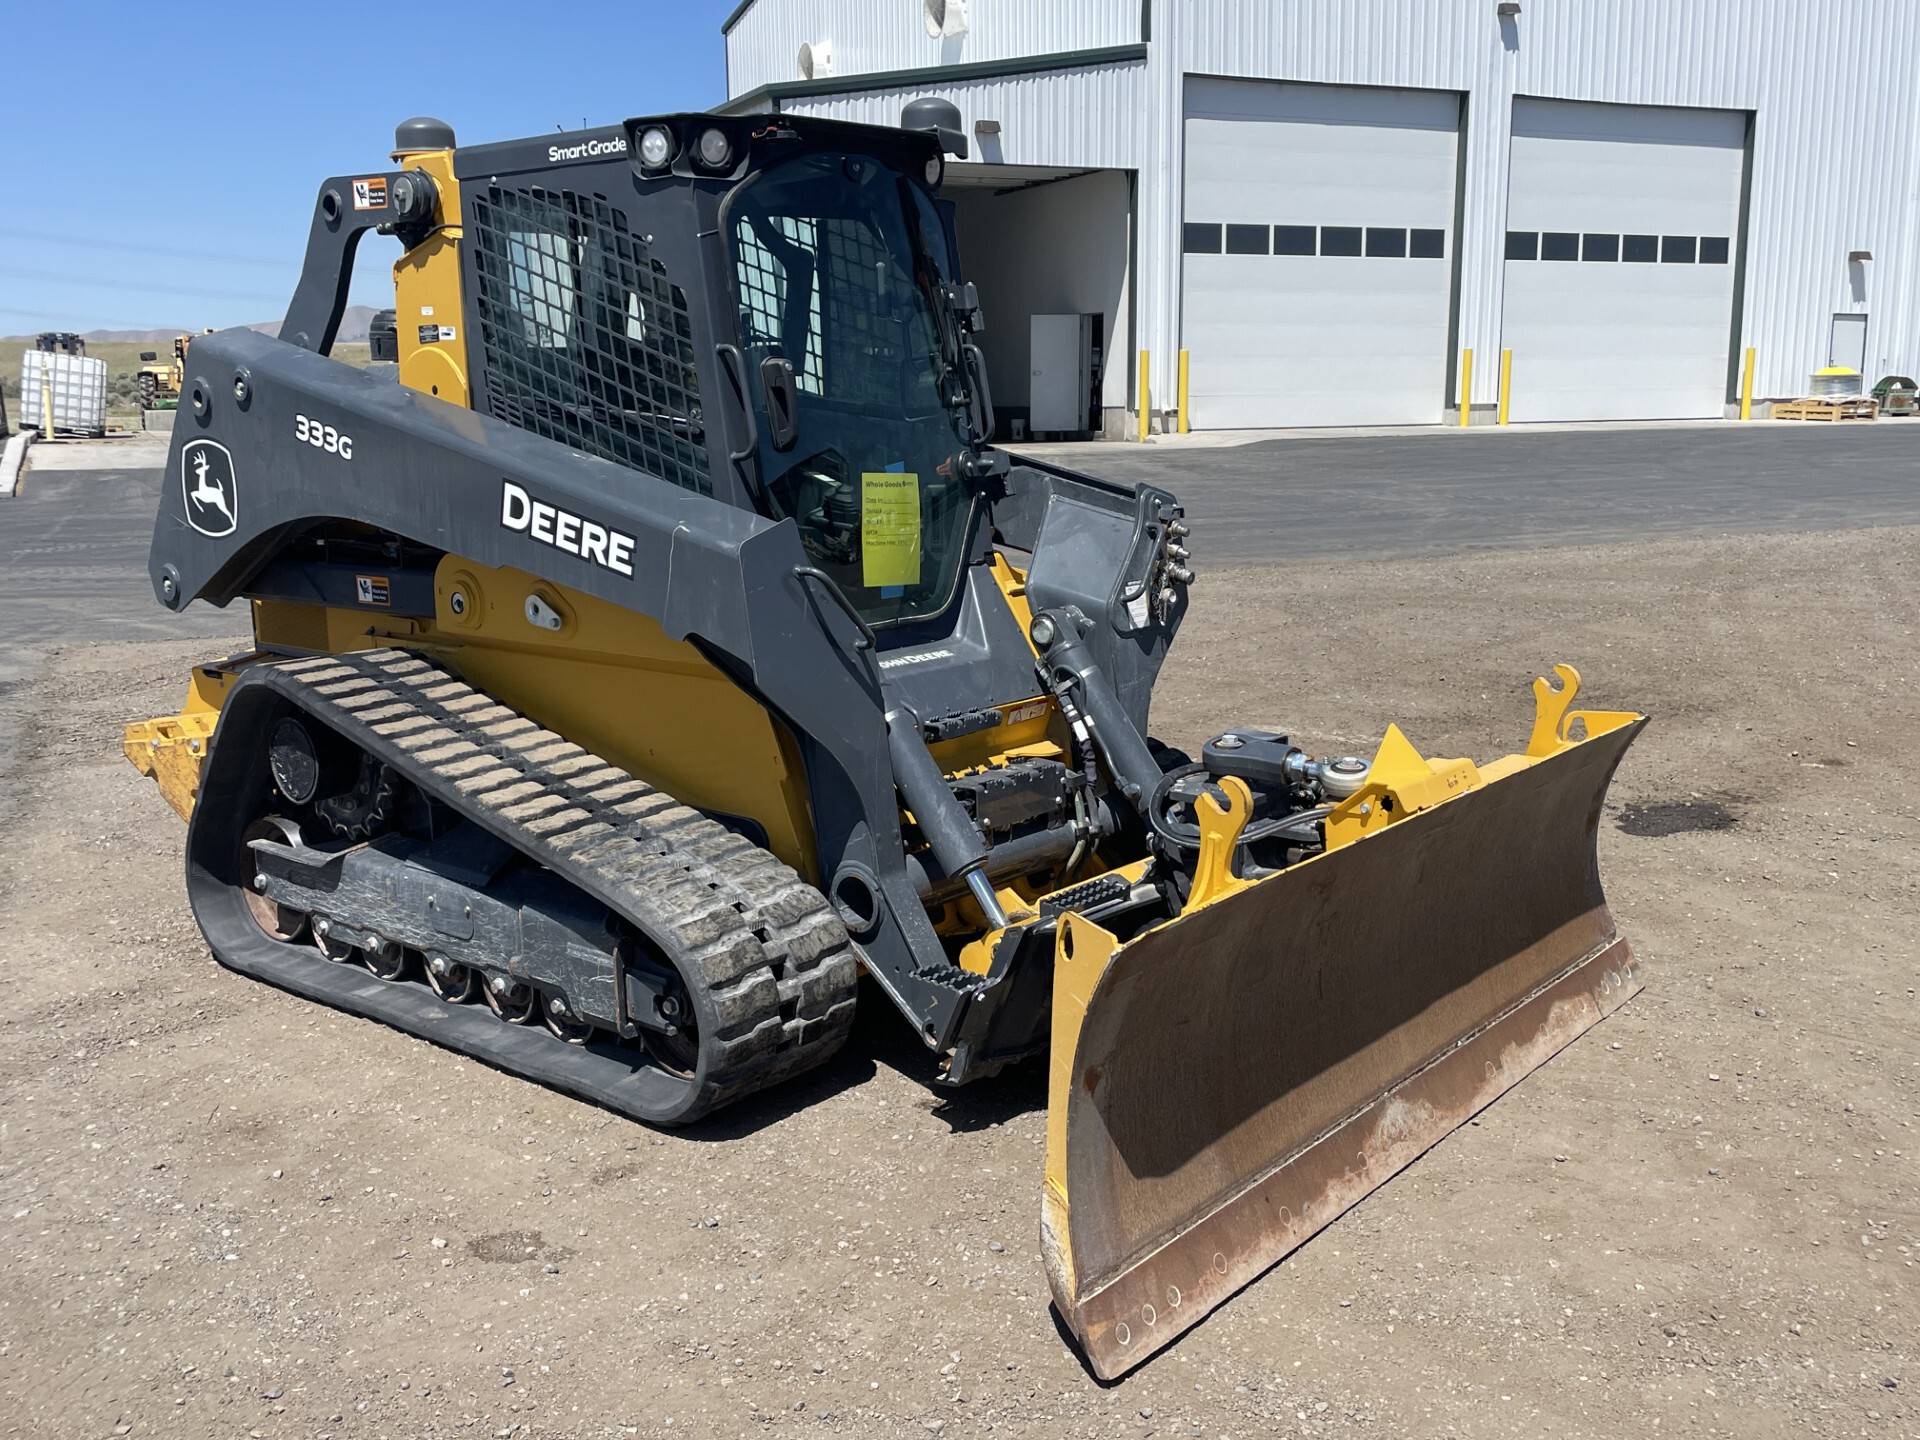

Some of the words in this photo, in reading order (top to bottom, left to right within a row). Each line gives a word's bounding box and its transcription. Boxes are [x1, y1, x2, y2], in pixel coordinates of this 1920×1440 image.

[548, 143, 588, 162] Smart
[587, 136, 627, 155] Grade
[295, 414, 353, 460] 333G
[502, 482, 635, 576] DEERE
[879, 657, 909, 669] OHN
[905, 650, 954, 663] DEERE
